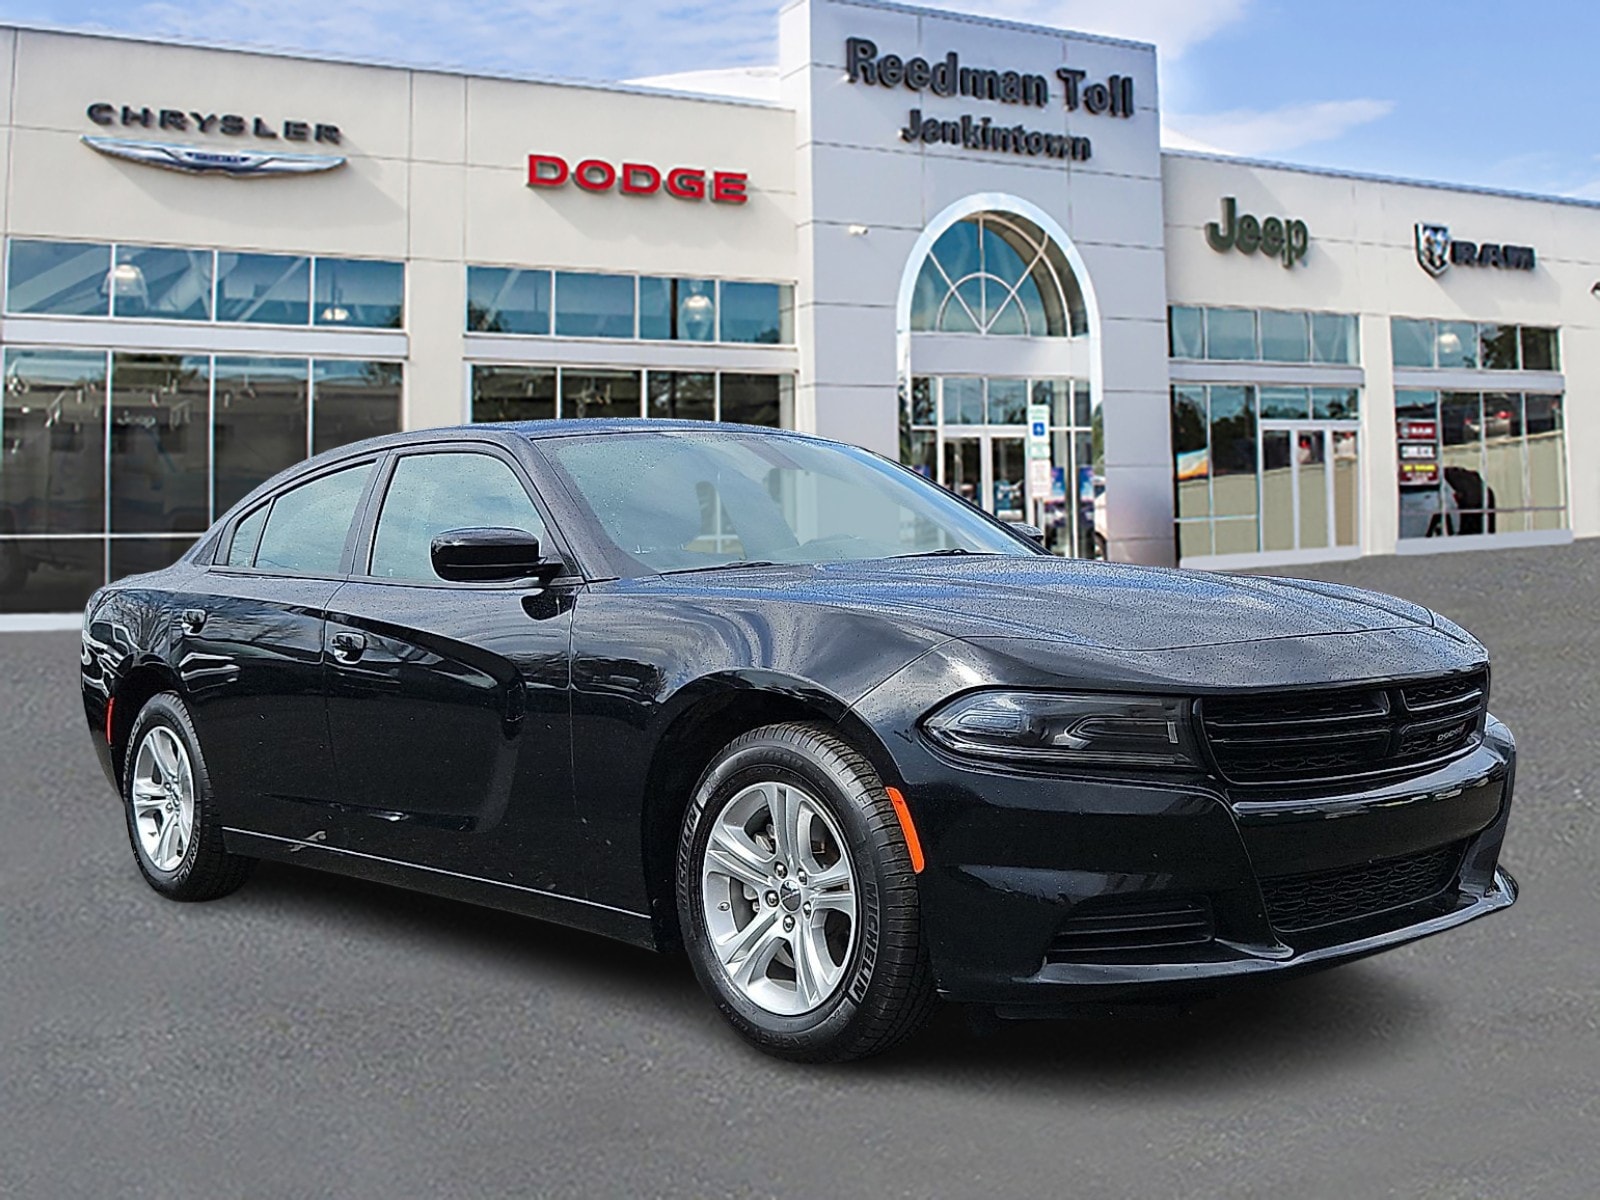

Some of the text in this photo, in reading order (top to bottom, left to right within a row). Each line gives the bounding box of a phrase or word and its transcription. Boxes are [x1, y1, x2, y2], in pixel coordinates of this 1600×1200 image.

[846, 36, 1135, 119] Reedman Toll
[87, 102, 342, 145] CHRYSLER
[901, 108, 1092, 161] Jenkintown
[527, 154, 749, 205] DODGE
[1204, 196, 1308, 269] Jeep
[1450, 240, 1536, 270] RAM
[851, 881, 880, 1003] MICHELIN
